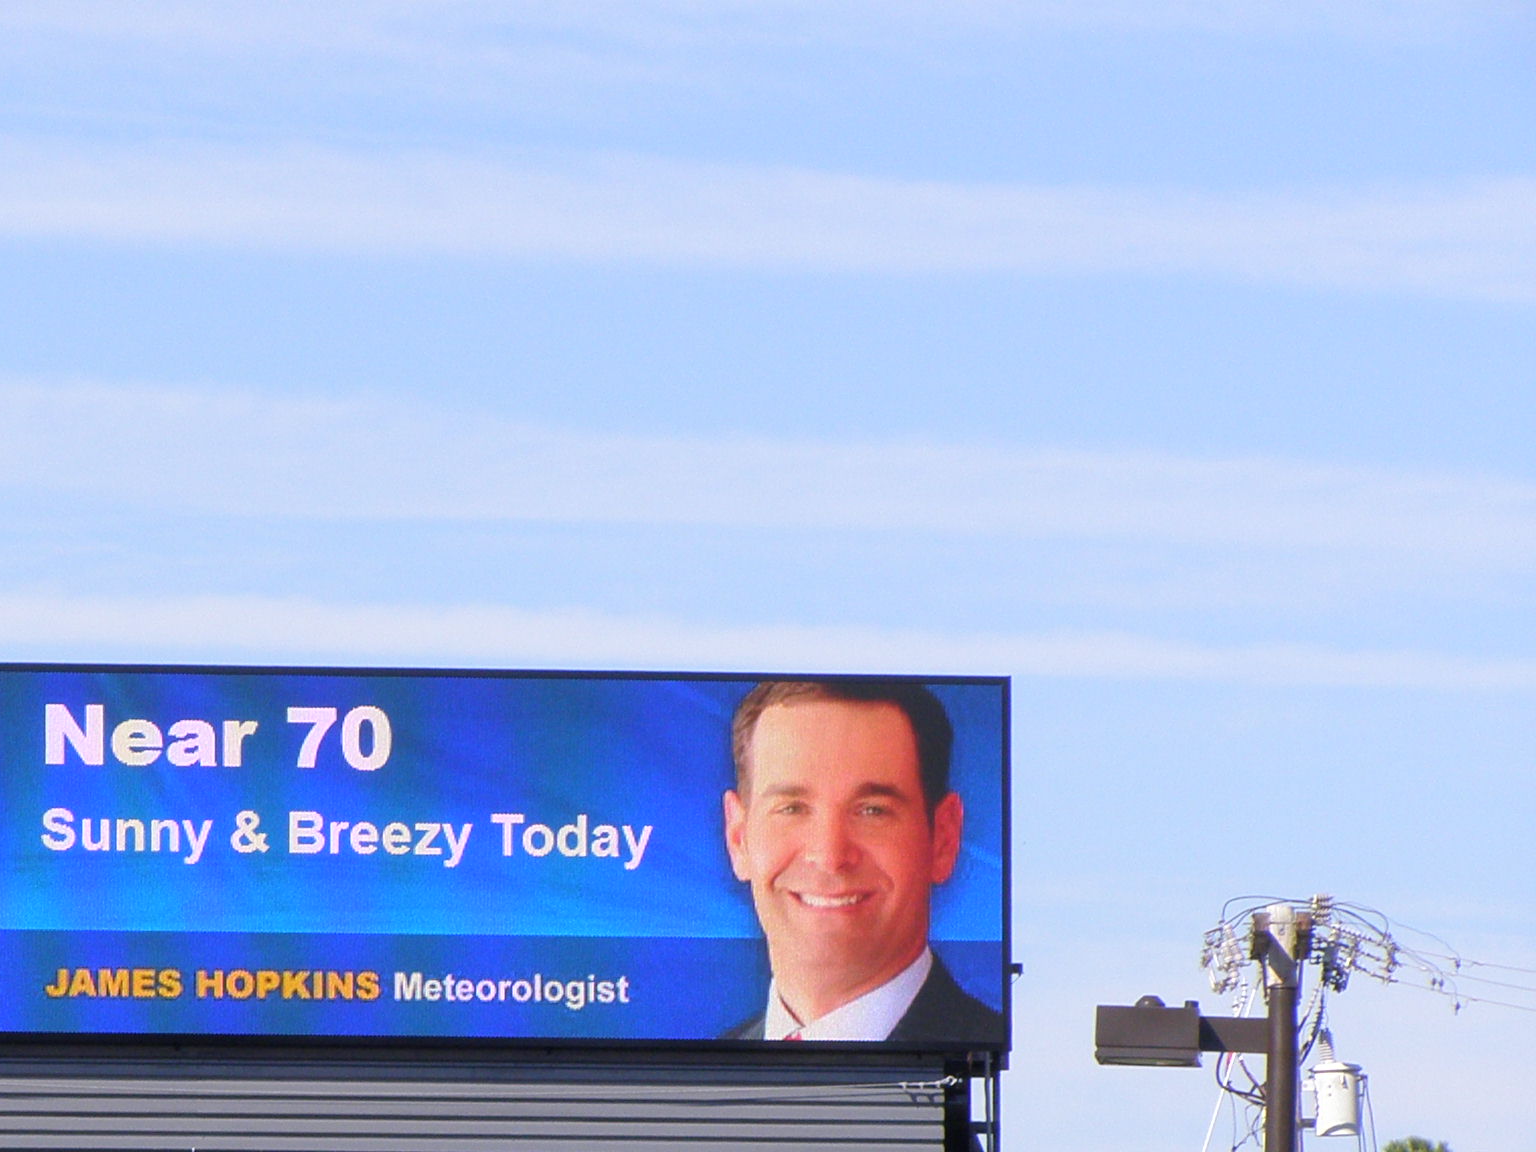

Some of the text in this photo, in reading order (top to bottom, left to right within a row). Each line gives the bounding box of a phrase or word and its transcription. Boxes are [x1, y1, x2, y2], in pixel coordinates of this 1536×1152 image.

[44, 703, 393, 771] Near 70
[41, 807, 653, 870] Sunny & Breezy Today
[44, 968, 630, 1010] JAMES HOPKINS Meteorologist
